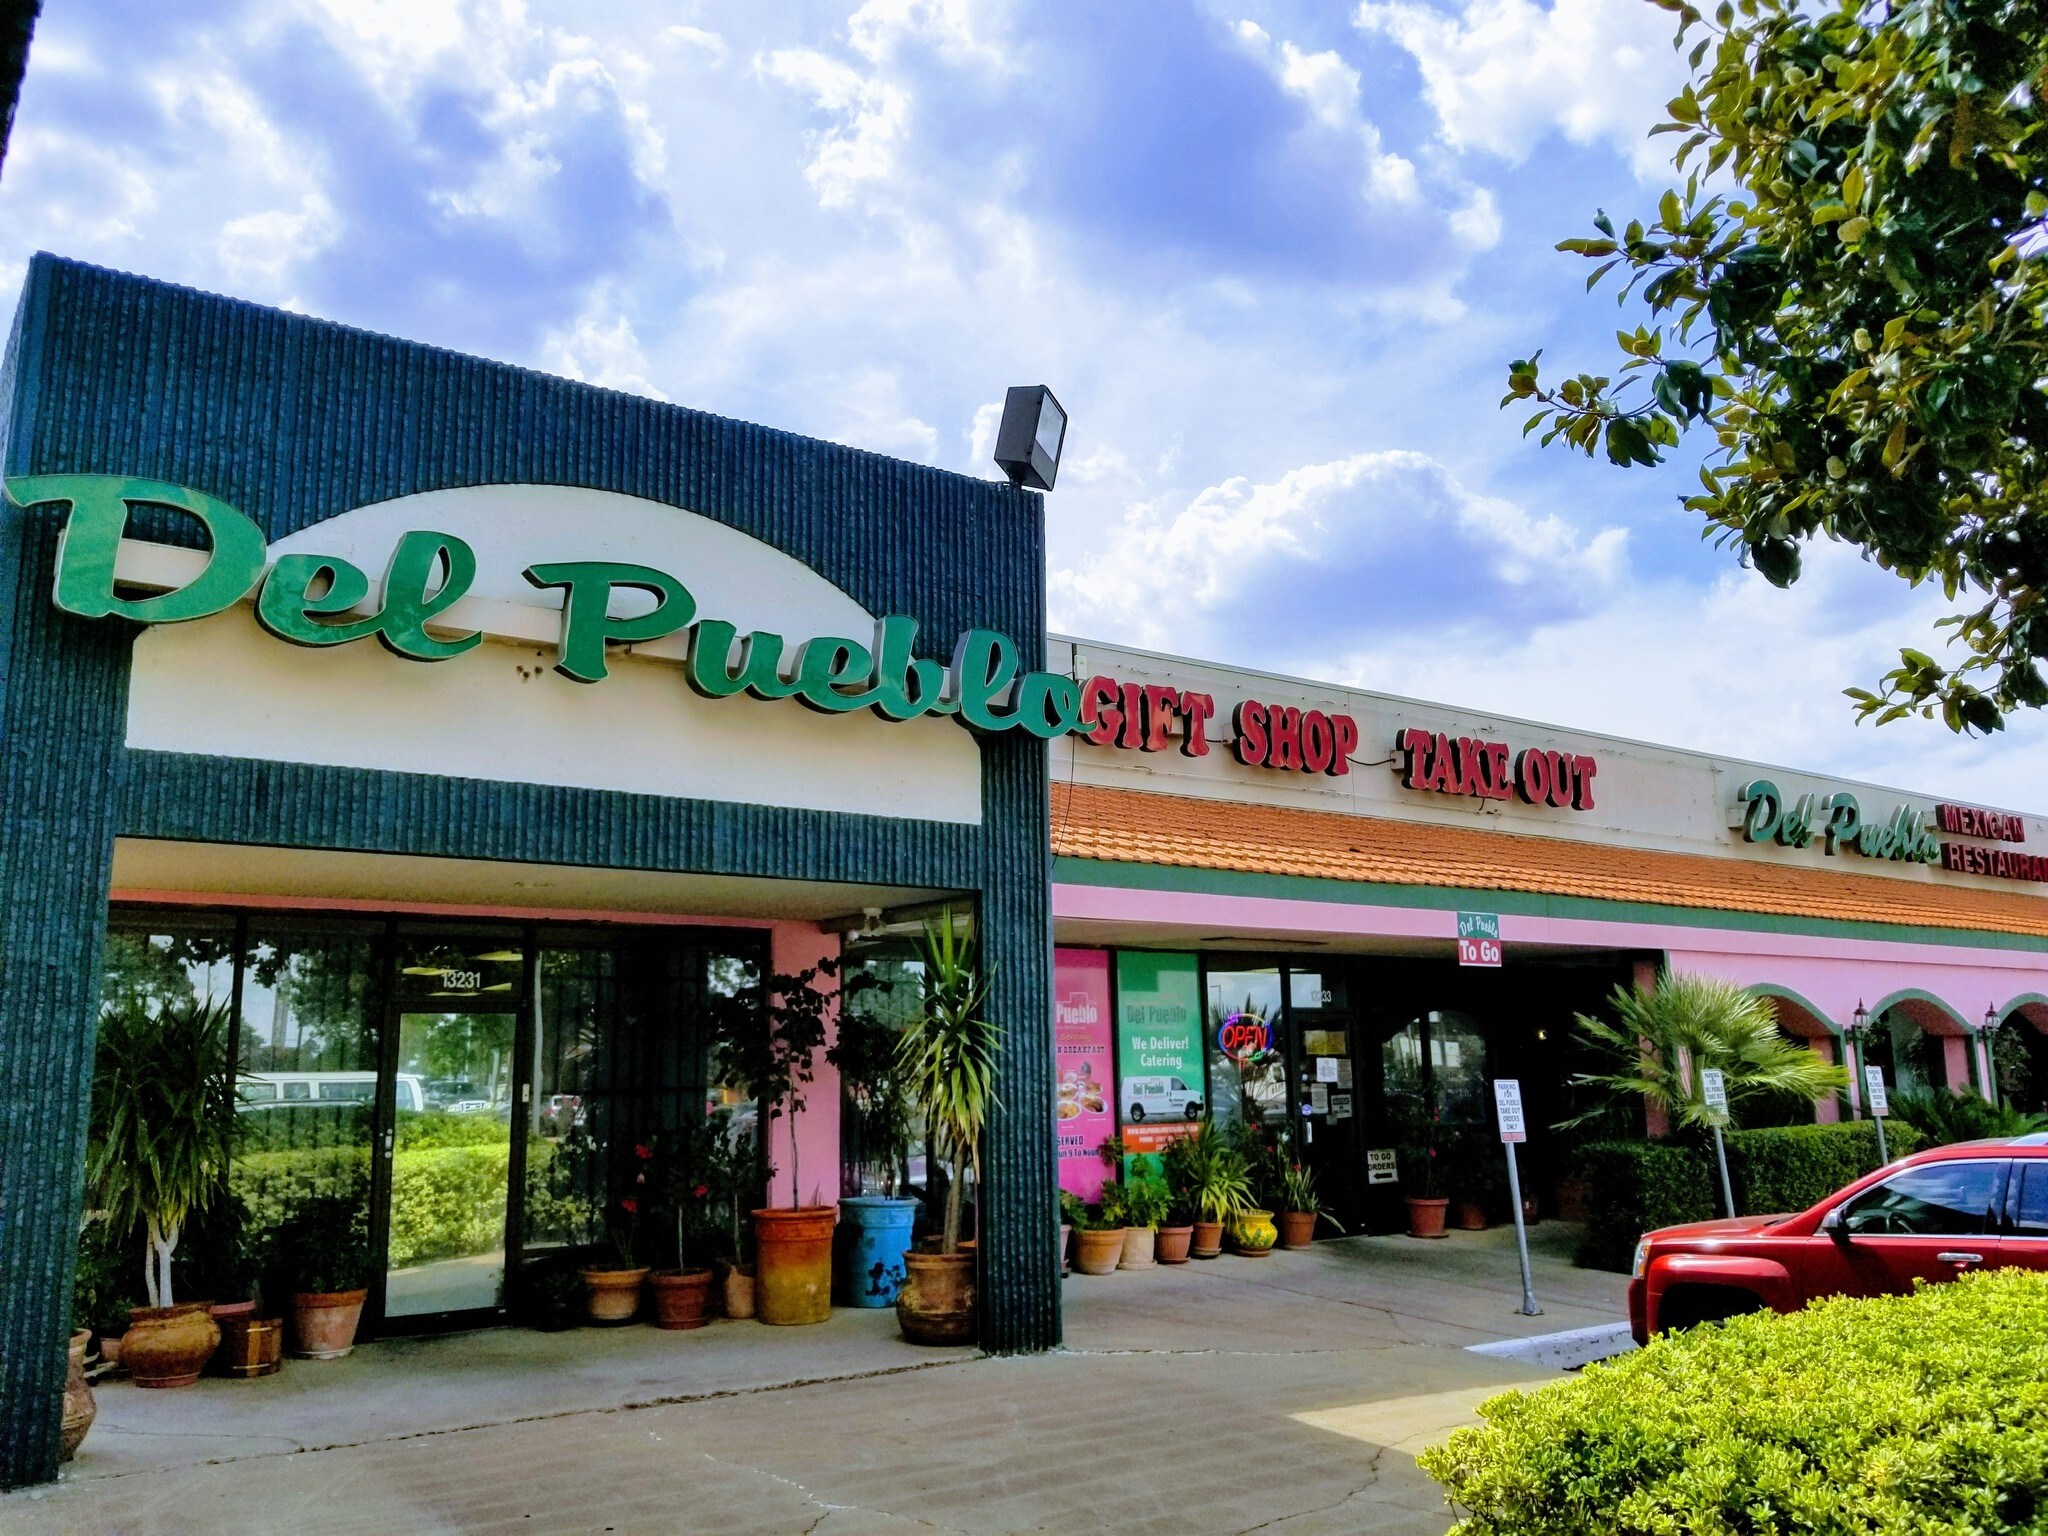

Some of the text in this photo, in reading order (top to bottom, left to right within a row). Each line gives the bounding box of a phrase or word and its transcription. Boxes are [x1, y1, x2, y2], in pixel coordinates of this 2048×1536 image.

[4, 473, 1098, 739] Del Pueblo
[1080, 675, 1359, 776] GIFT SHOP
[1396, 727, 1598, 811] TAKE OUT
[1738, 779, 1940, 865] Del Pueblo
[1935, 803, 2026, 843] MEXICAN
[1940, 842, 2048, 883] RESTAURA
[1459, 915, 1498, 938] Del Pueblo
[1460, 939, 1499, 962] To Go
[441, 970, 481, 989] 13231
[1311, 989, 1332, 1003] 13233
[1055, 1003, 1098, 1025] Pueblo
[1126, 1004, 1187, 1024] Del Pueblo
[1131, 1036, 1189, 1050] We Deliver!
[1221, 1025, 1269, 1050] OPEN
[1063, 1045, 1105, 1054] BREAKFAST
[1140, 1053, 1182, 1070] Catering
[1057, 1136, 1083, 1146] SERVED
[1368, 1162, 1396, 1171] ORDERS
[1370, 1153, 1379, 1161] TO
